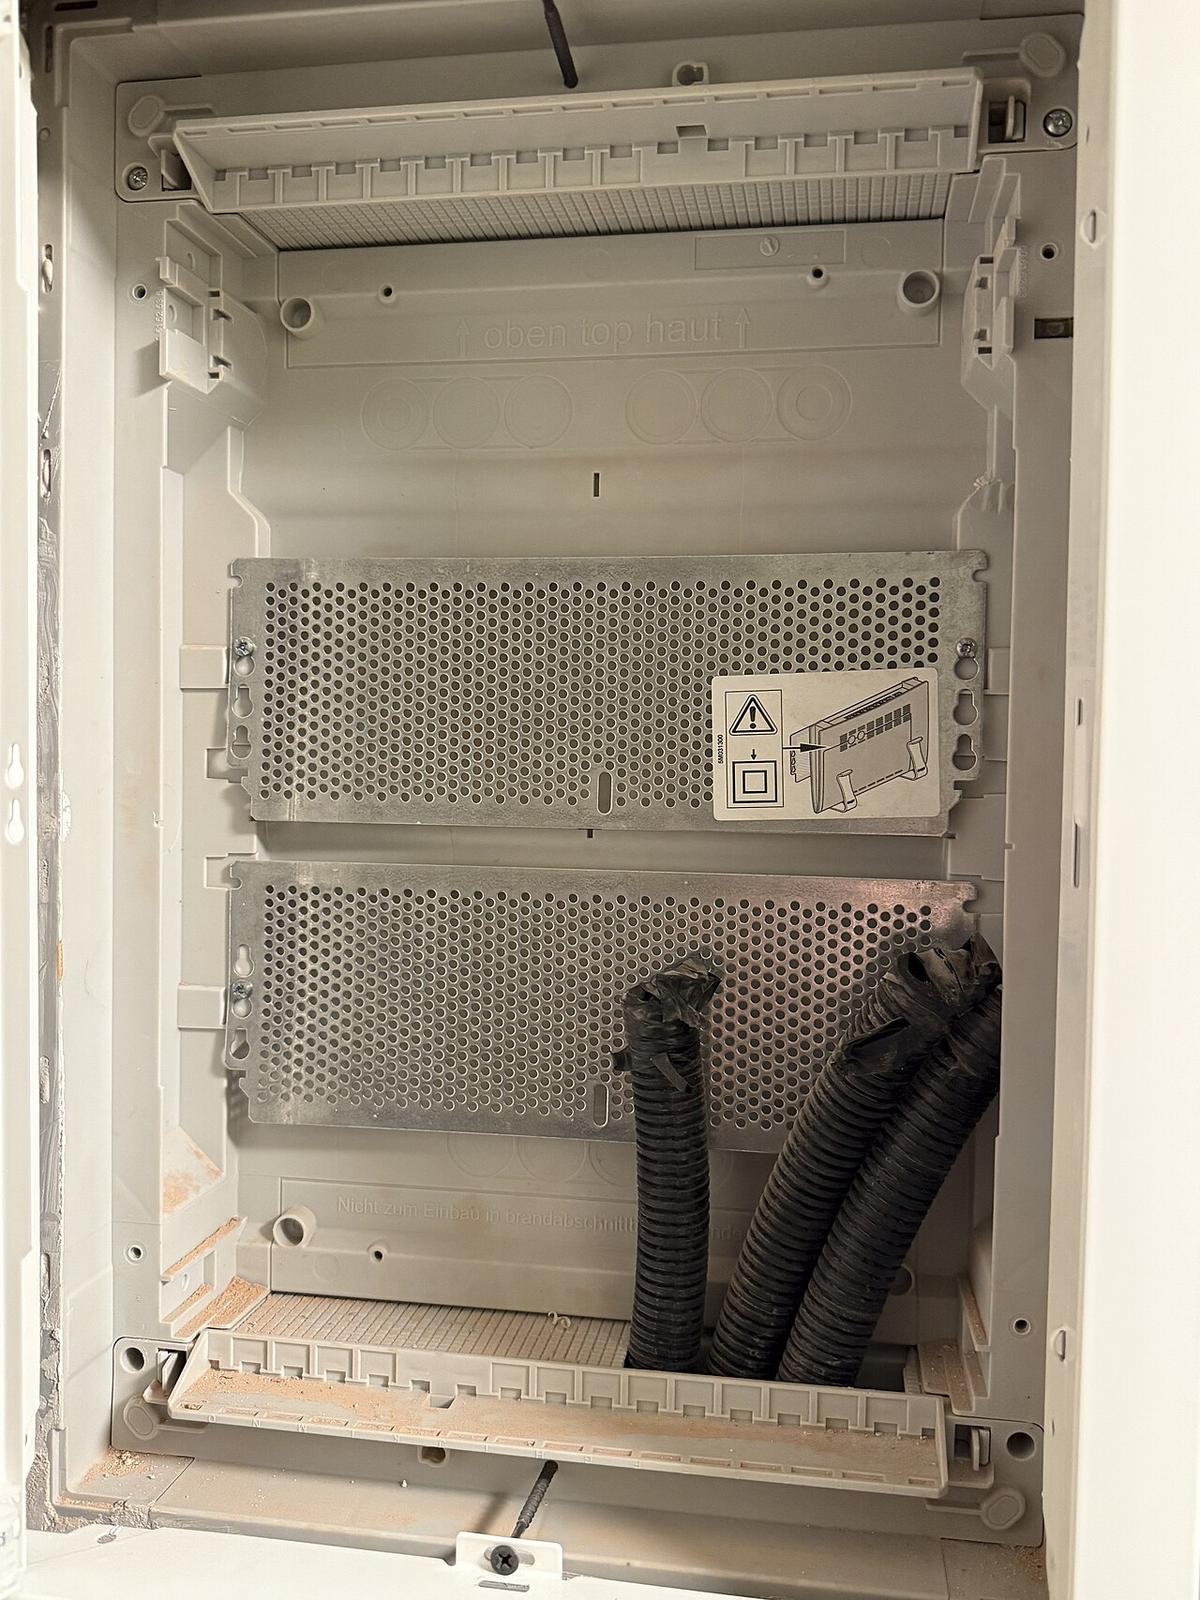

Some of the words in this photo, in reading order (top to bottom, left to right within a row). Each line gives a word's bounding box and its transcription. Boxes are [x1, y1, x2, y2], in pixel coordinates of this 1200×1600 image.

[483, 319, 568, 350] oben
[580, 317, 632, 351] top
[645, 311, 722, 344] haut
[337, 1196, 379, 1214] Nicht
[383, 1202, 418, 1217] zum
[423, 1200, 481, 1220] Einbau
[486, 1207, 500, 1224] in
[505, 1206, 638, 1232] brandabschnittb
